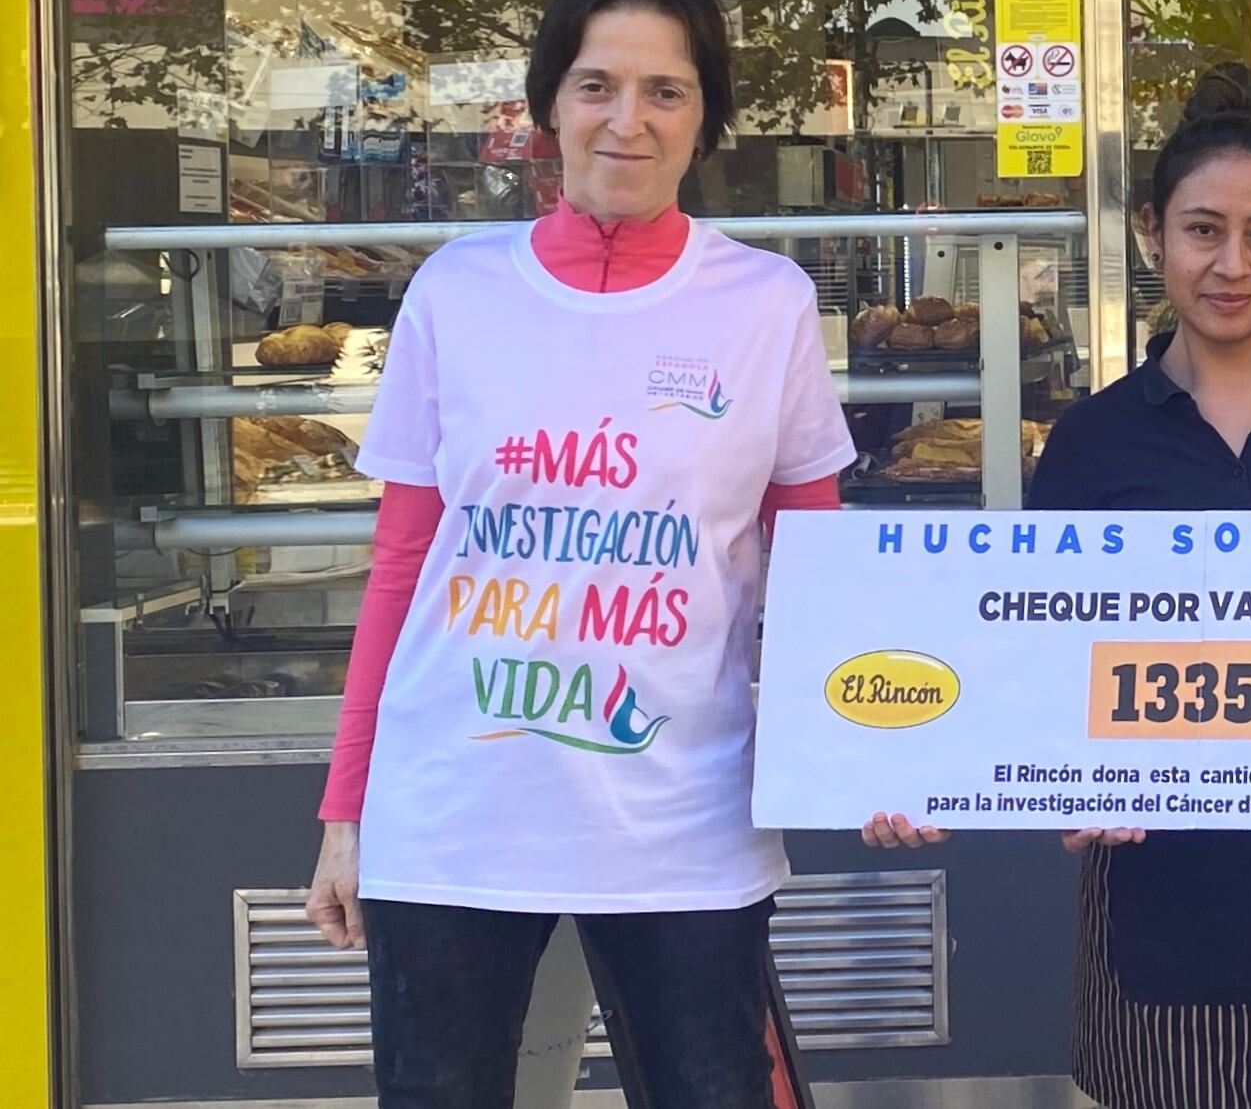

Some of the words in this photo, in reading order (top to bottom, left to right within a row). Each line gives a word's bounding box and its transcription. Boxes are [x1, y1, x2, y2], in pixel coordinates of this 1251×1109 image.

[648, 370, 707, 387] CMM
[496, 417, 638, 489] #MÁS
[456, 499, 701, 567] INVESTIGACIÓN
[877, 523, 1125, 554] HUCHAS
[448, 575, 561, 642] PARA
[579, 571, 689, 648] MÁS
[978, 592, 1120, 624] CHEQUE
[1129, 593, 1200, 623] POR
[473, 657, 593, 723] VIDA
[841, 674, 865, 703] El
[867, 674, 943, 704] Rincón
[994, 764, 1012, 783] El
[1017, 764, 1082, 784] Rincón
[1092, 764, 1140, 784] dona
[1149, 765, 1191, 784] esta
[926, 797, 970, 815] para
[975, 795, 992, 812] la
[997, 794, 1126, 817] investigación
[1131, 794, 1160, 813] del
[1165, 794, 1233, 814] Cáncer
